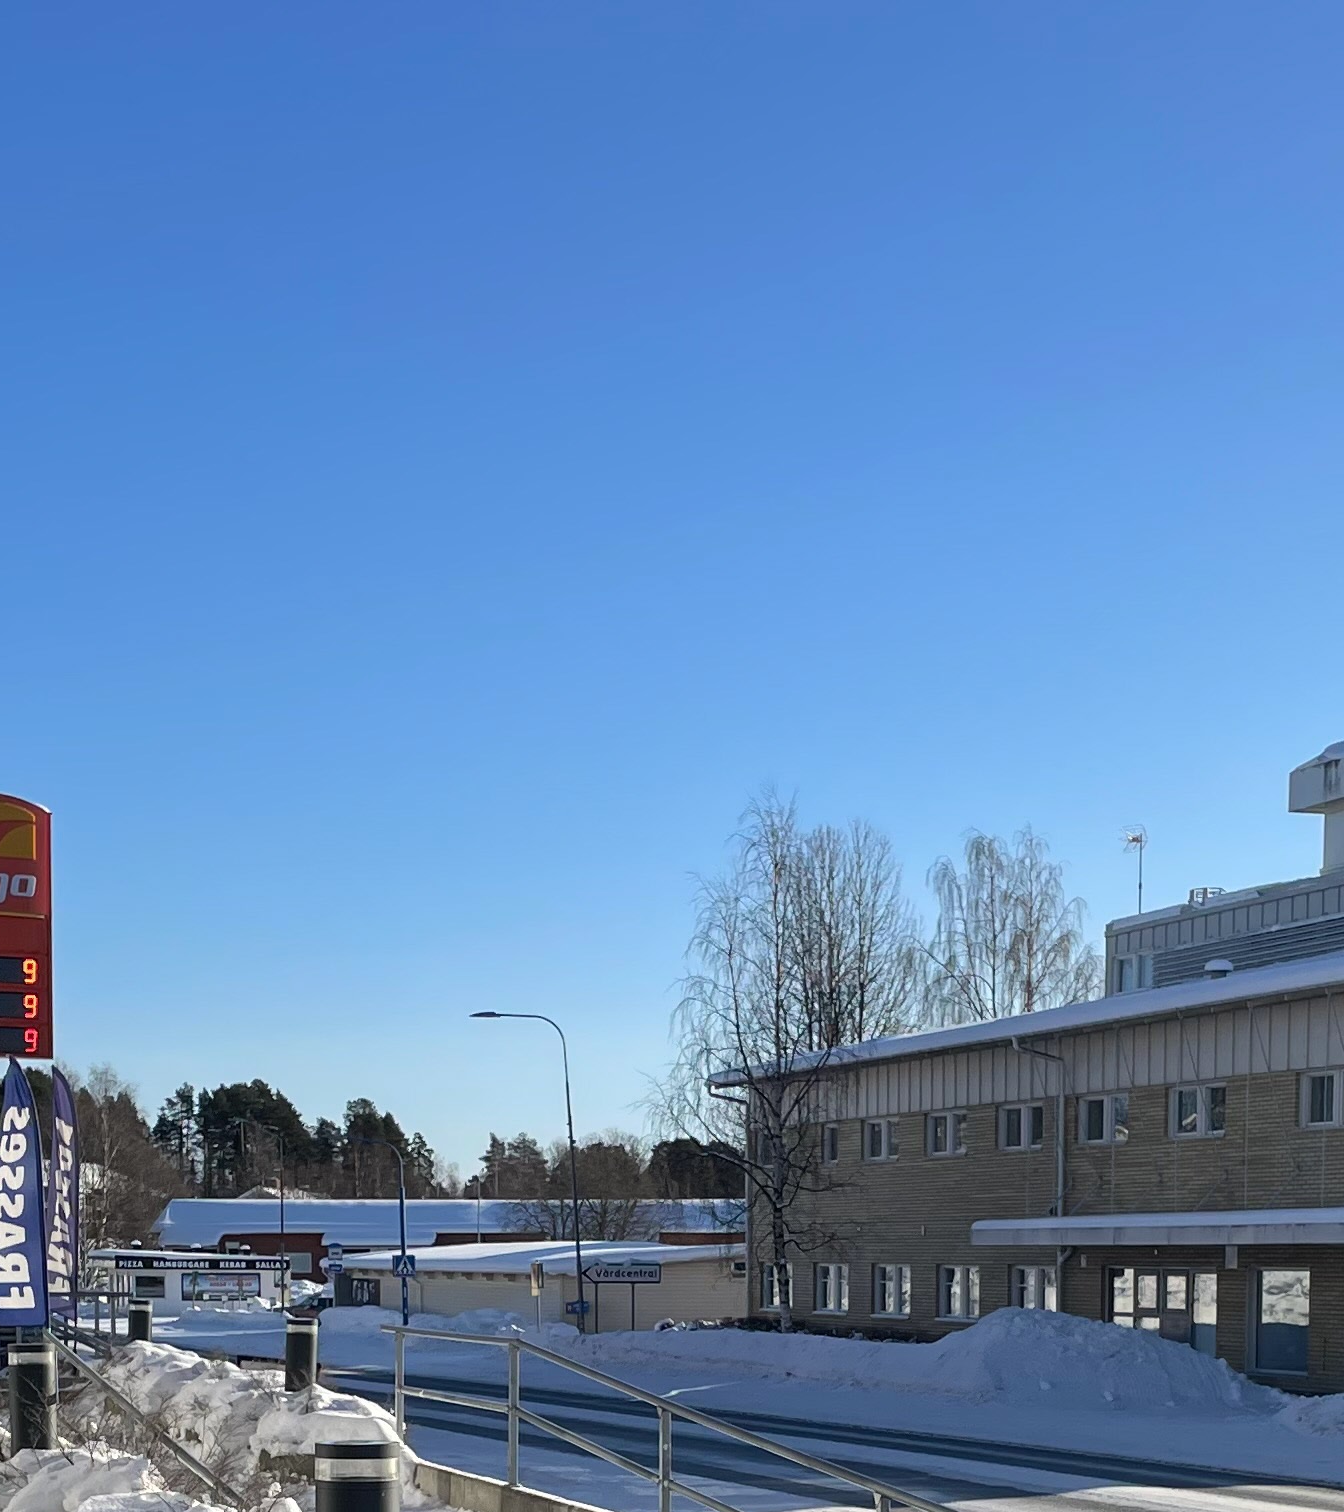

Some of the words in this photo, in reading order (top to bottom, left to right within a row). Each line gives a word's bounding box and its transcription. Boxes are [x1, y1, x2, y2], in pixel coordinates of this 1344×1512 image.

[22, 958, 37, 984] 9
[23, 994, 38, 1019] 9
[24, 1028, 38, 1053] 9
[118, 1260, 144, 1268] PIZZA
[153, 1260, 210, 1269] HAMBURGARE
[219, 1261, 247, 1269] KEBAB
[595, 1268, 657, 1279] Vårdcentral
